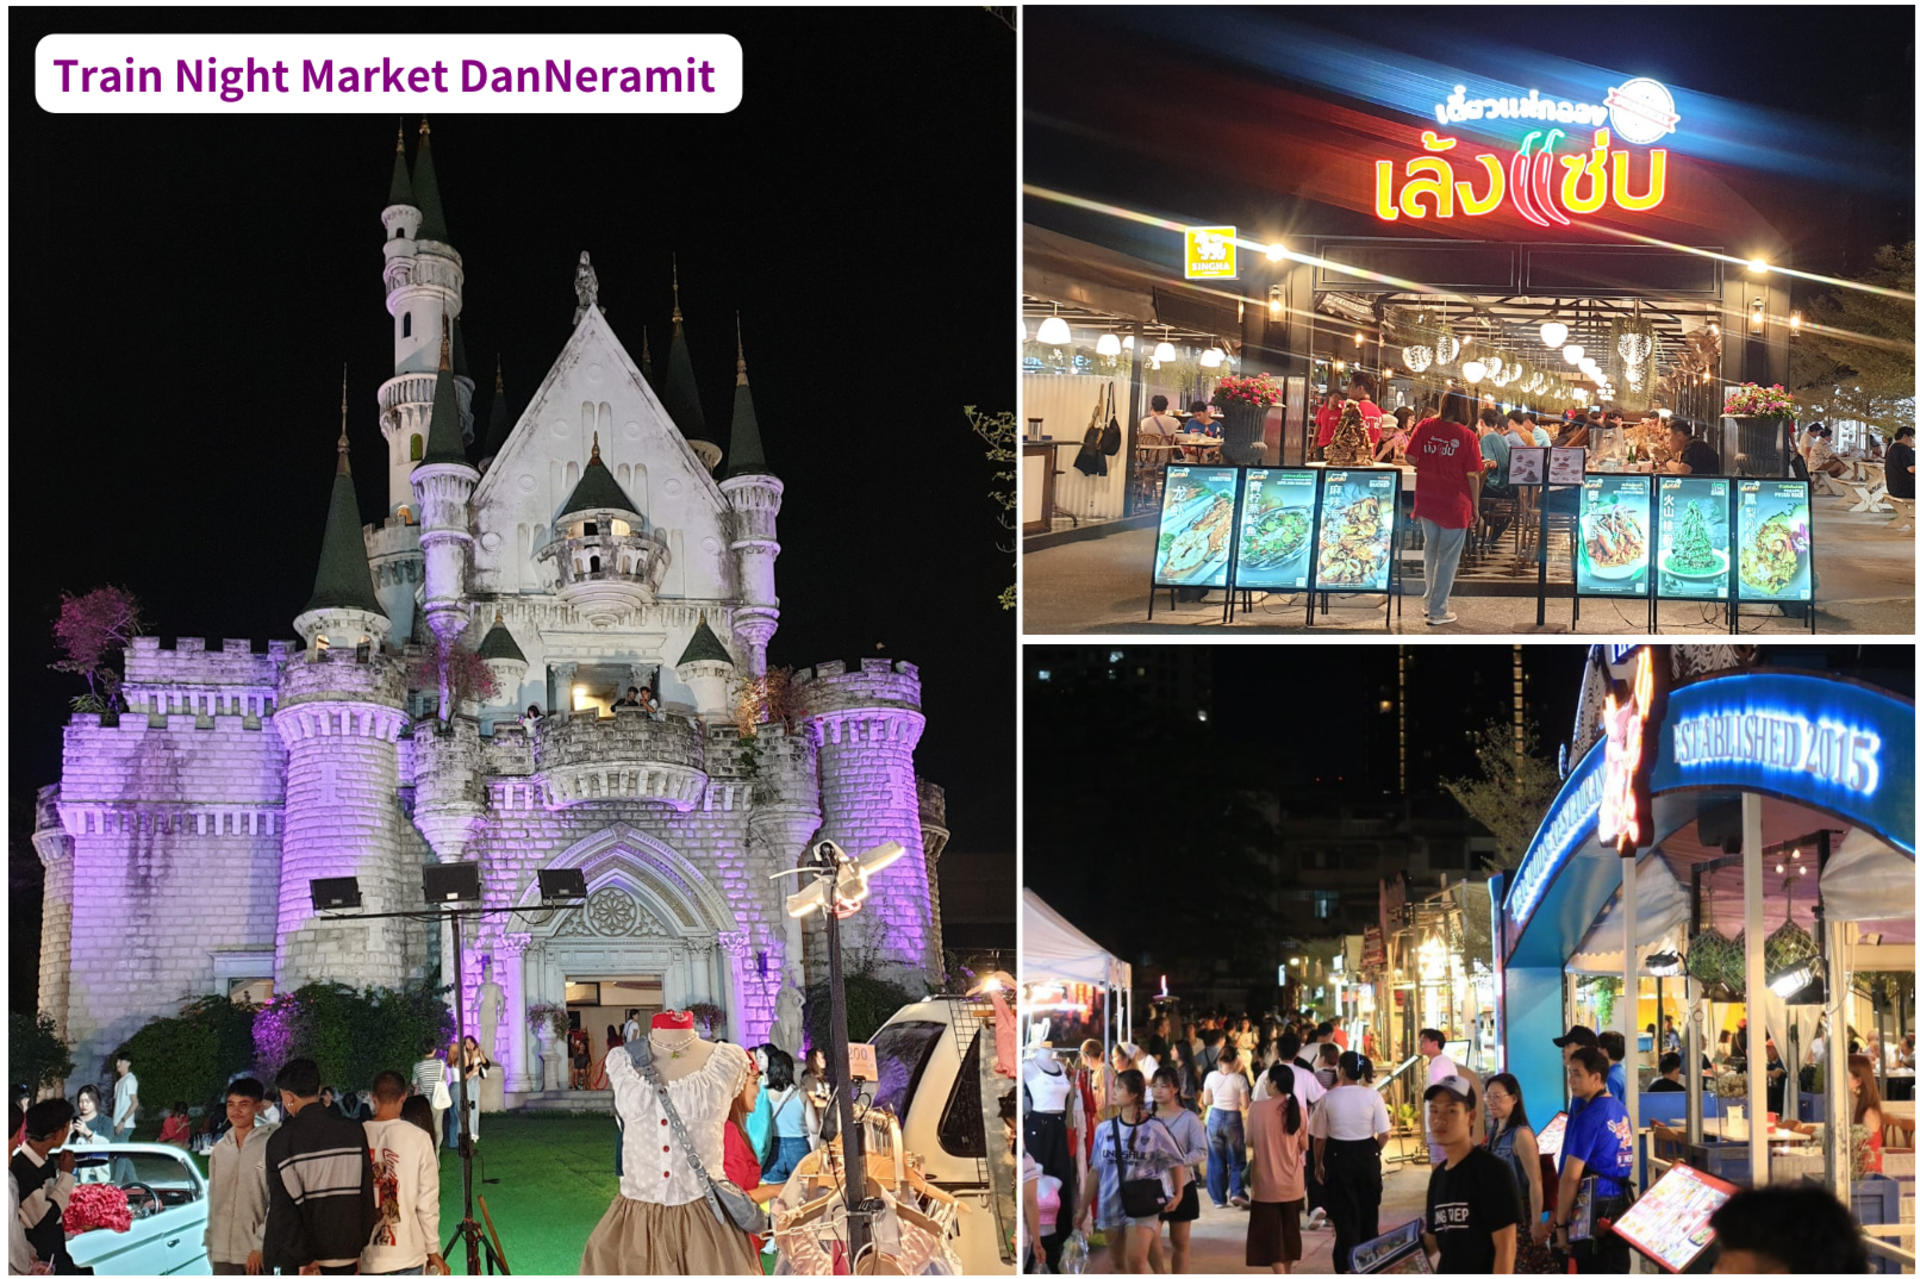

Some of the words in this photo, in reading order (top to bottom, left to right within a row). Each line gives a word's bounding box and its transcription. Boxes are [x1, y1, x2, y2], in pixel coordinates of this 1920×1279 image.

[1191, 262, 1231, 271] SINGHA
[1673, 714, 1801, 769] ESTABLISHED
[1806, 722, 1874, 793] 2015
